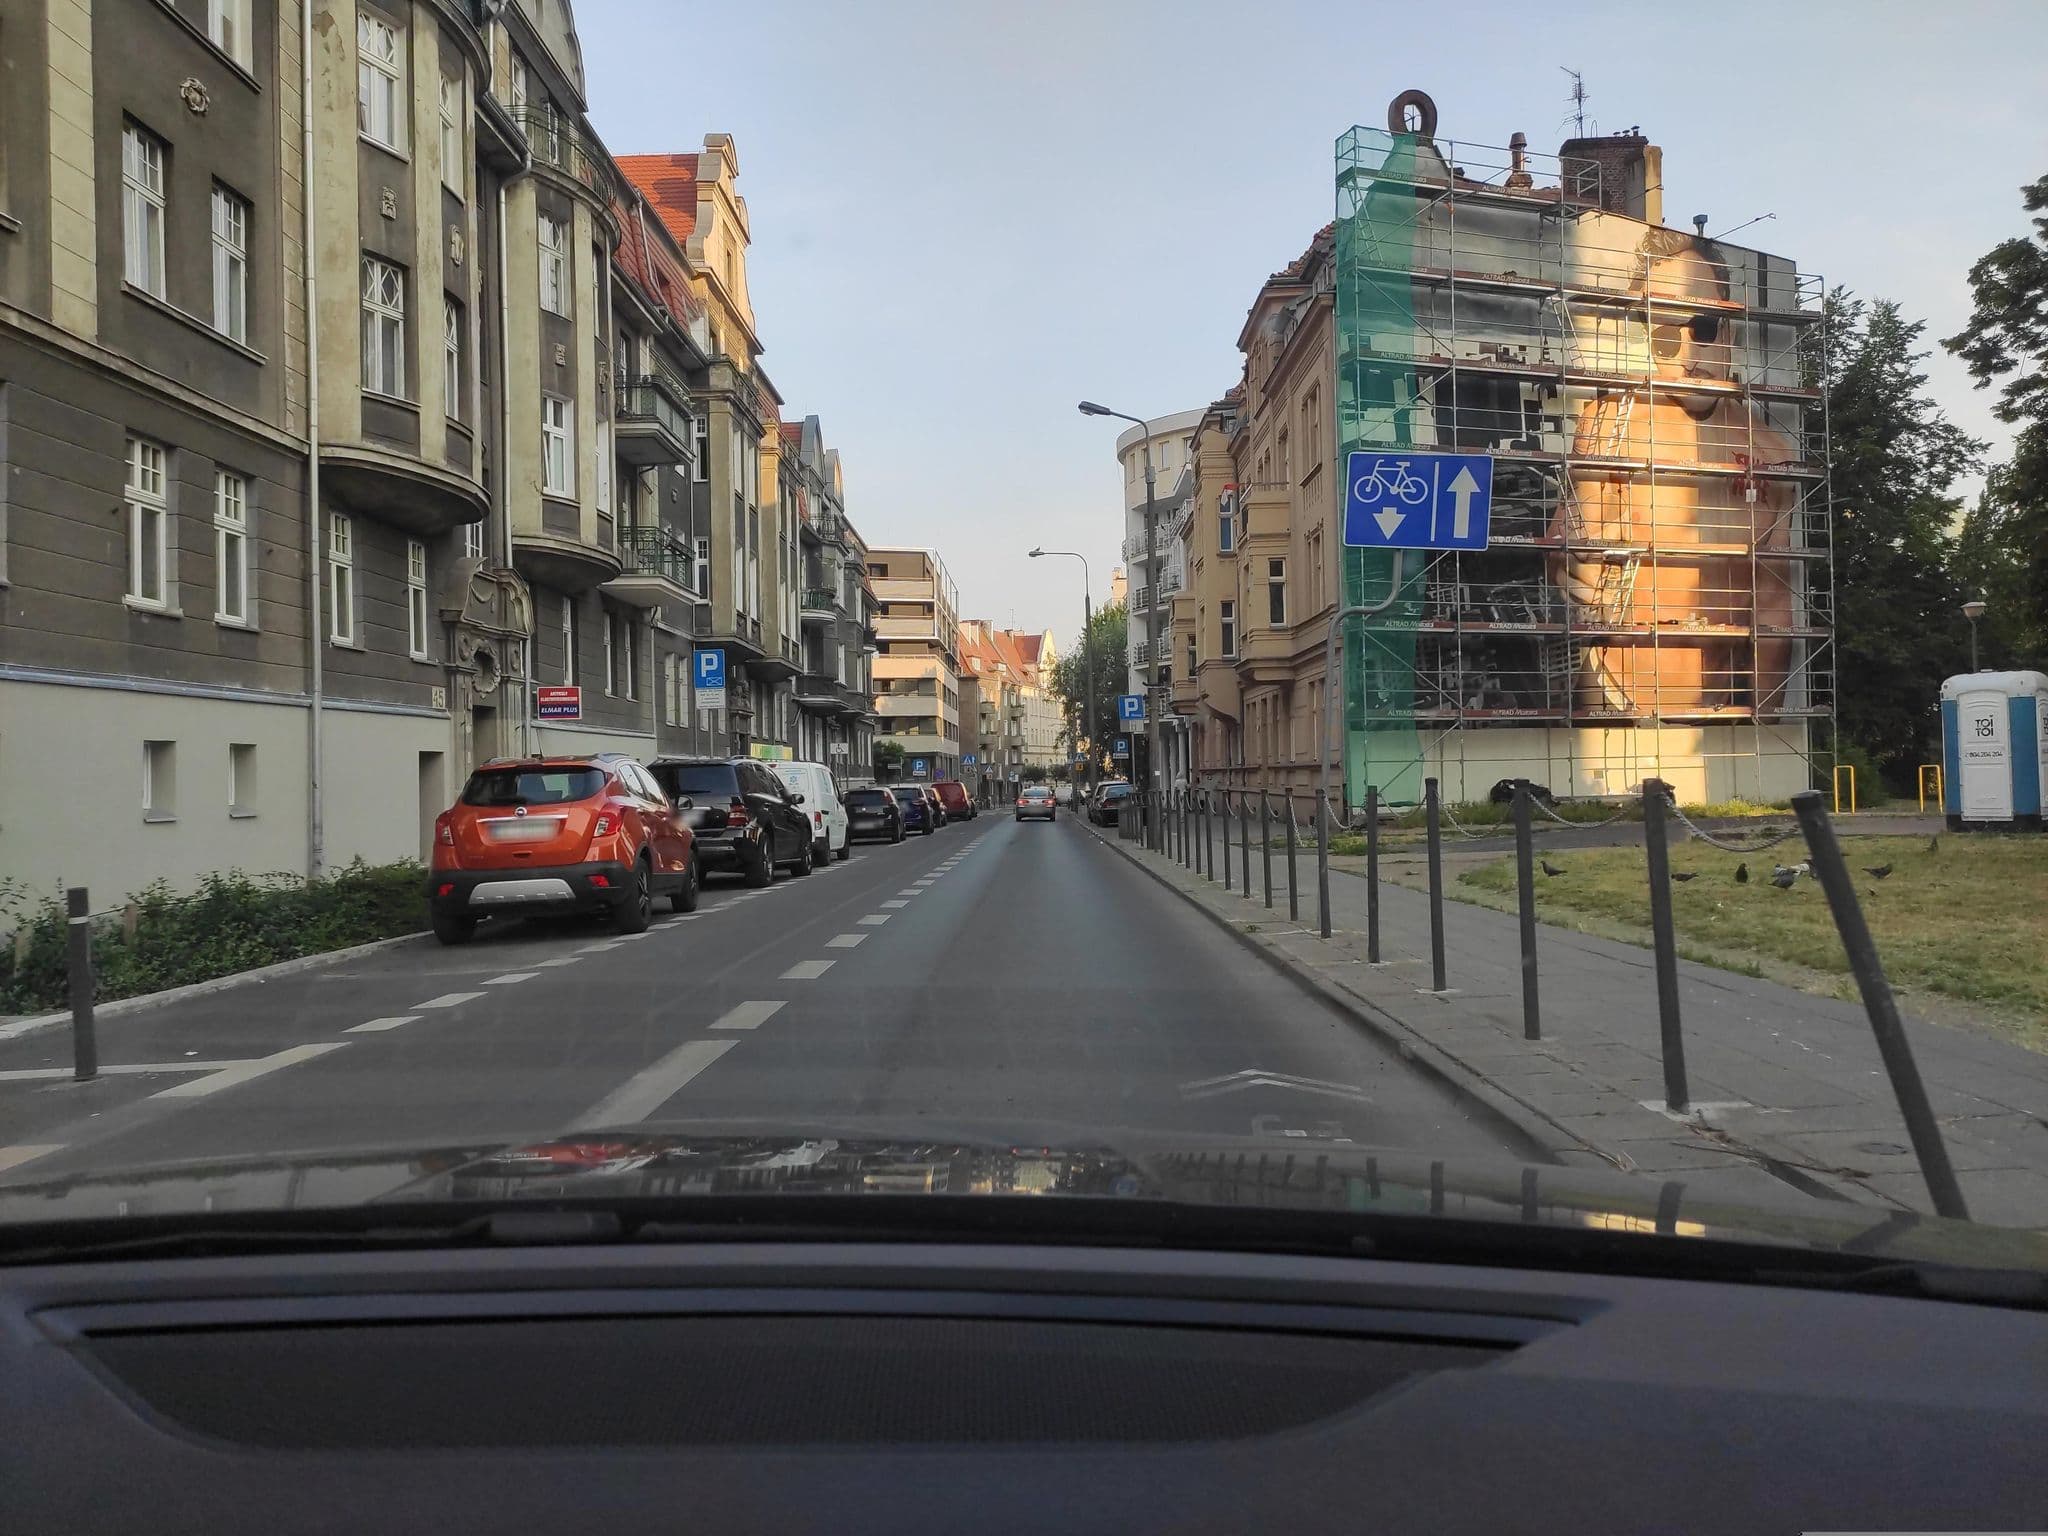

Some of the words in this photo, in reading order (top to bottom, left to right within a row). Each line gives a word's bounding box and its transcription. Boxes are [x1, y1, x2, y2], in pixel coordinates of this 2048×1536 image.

[701, 653, 718, 677] P
[433, 690, 443, 707] 45
[1124, 697, 1139, 717] P
[1974, 717, 1993, 727] TOI
[1975, 727, 1994, 737] TOI
[1117, 741, 1126, 752] P
[916, 760, 924, 771] P
